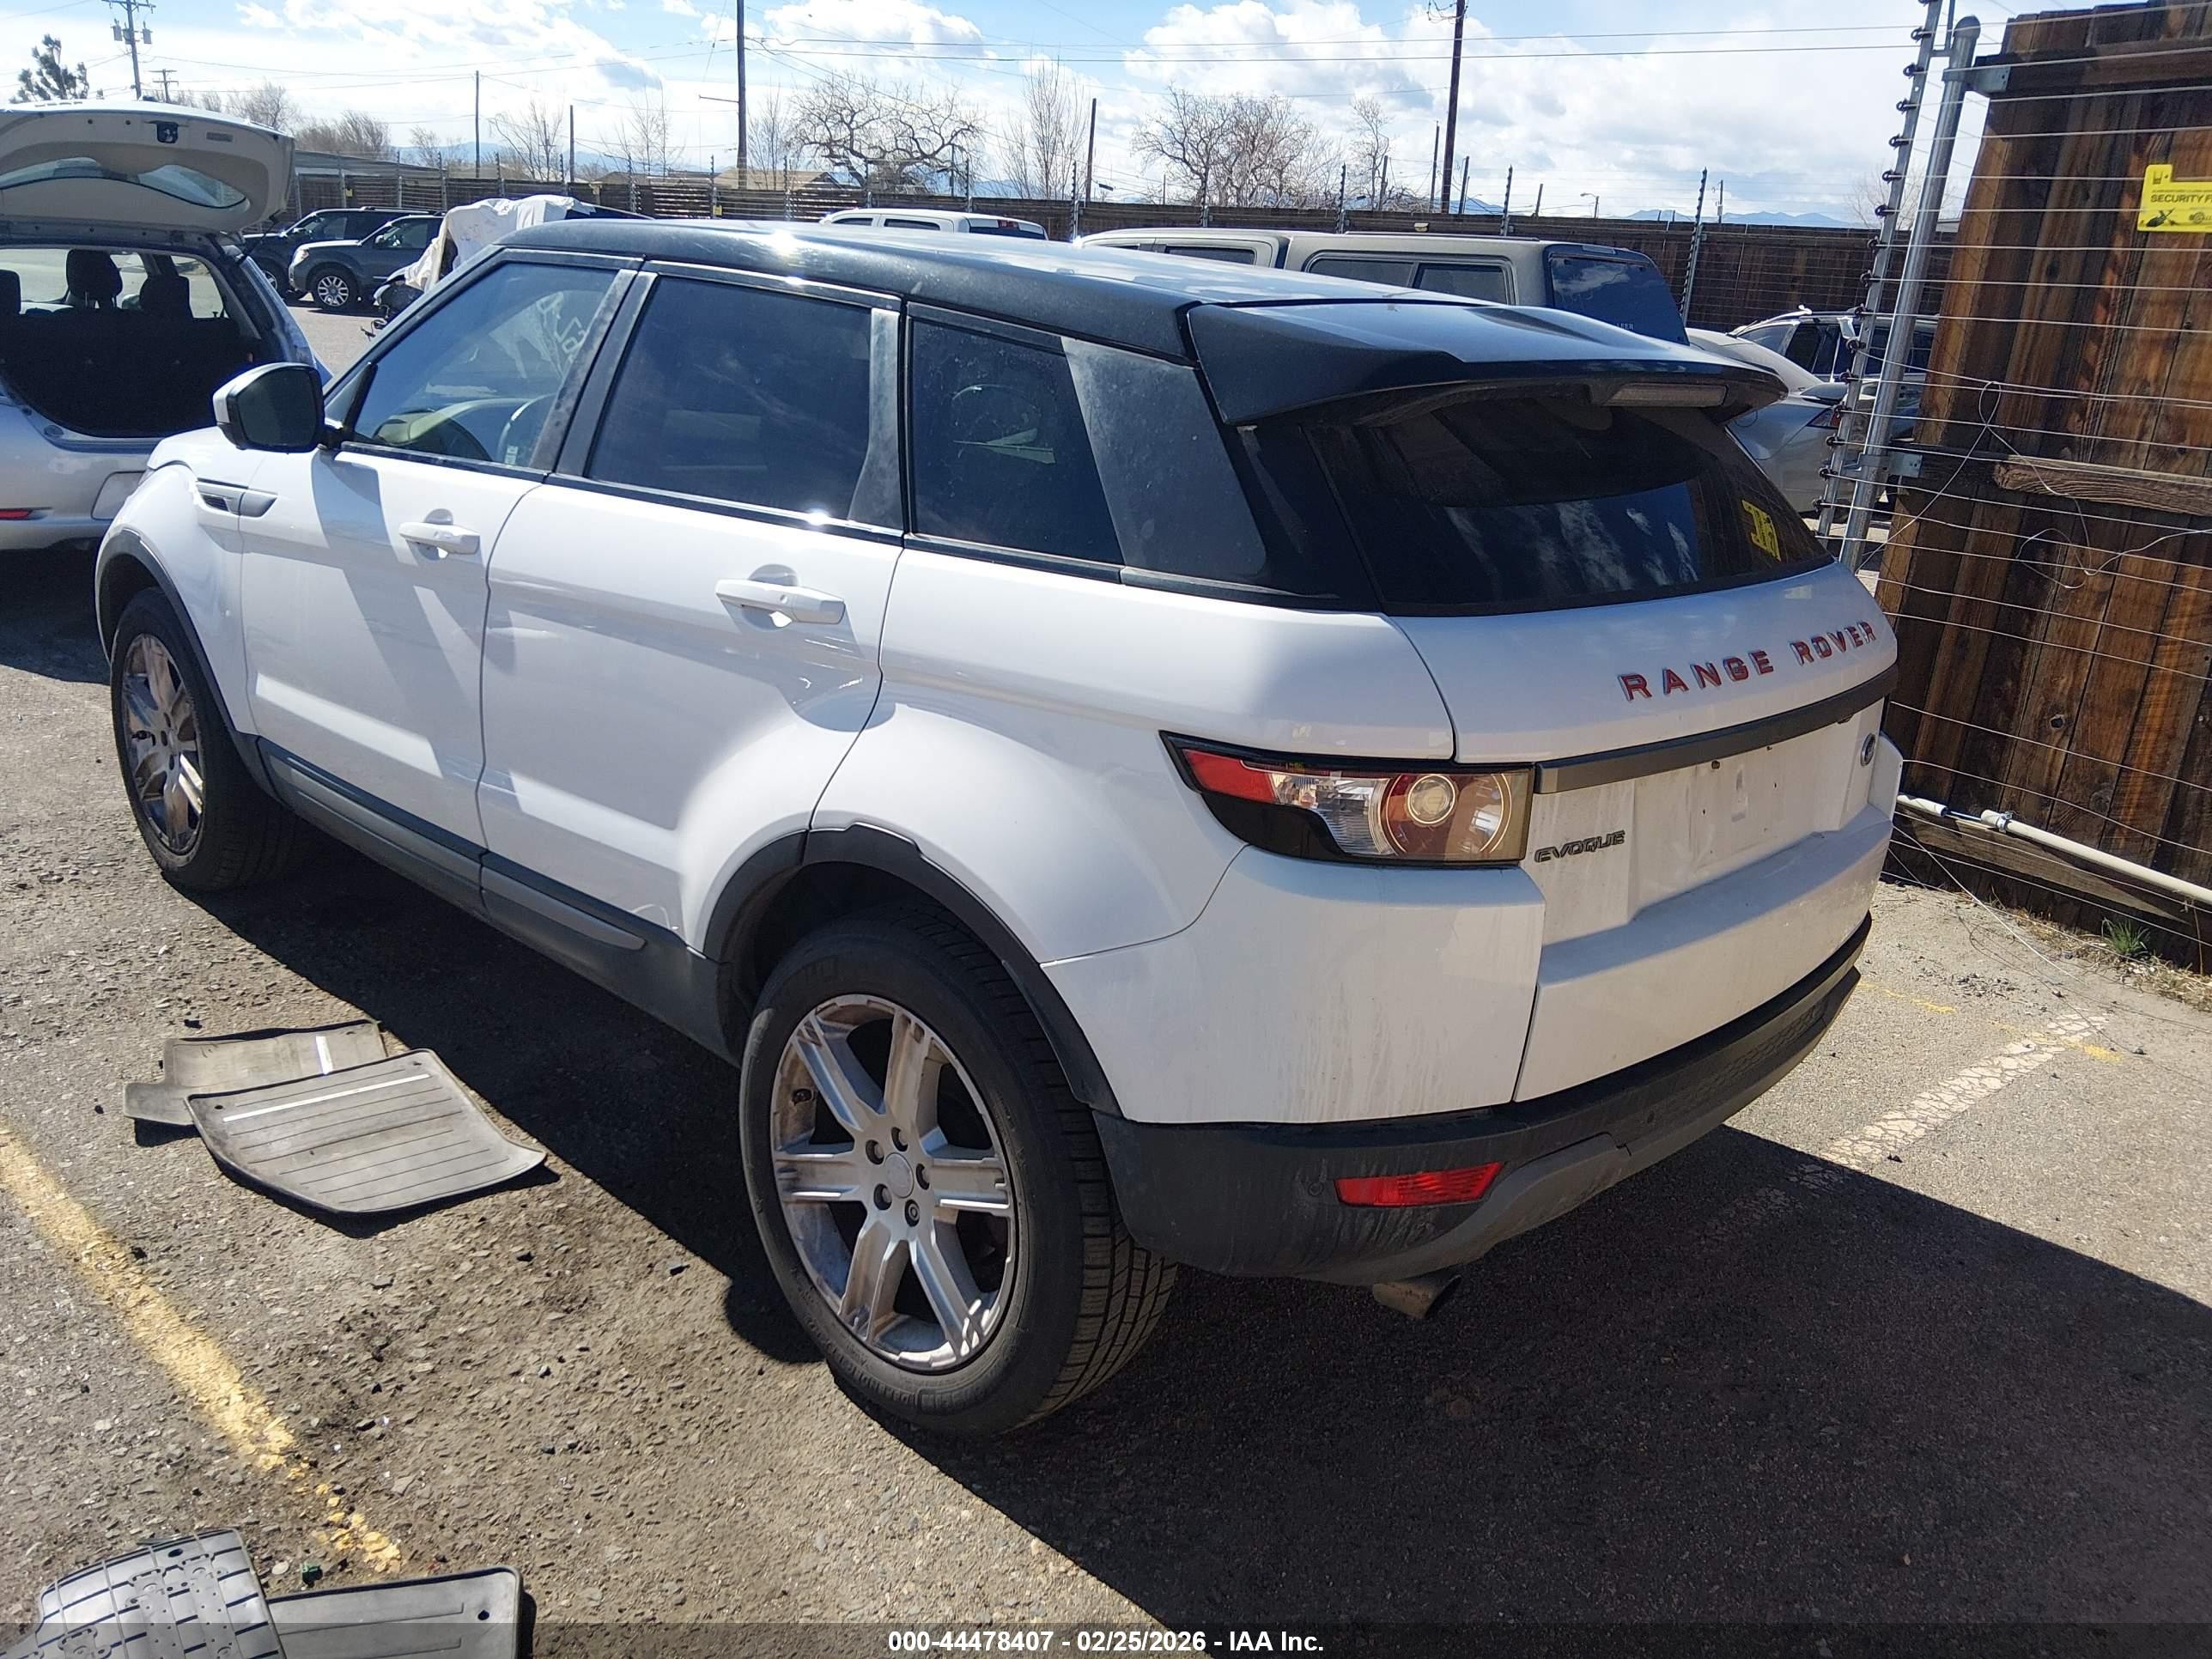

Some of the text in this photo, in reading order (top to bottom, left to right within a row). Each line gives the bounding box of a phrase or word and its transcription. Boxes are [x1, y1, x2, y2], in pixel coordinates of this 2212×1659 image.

[2150, 194, 2203, 203] SECURITY
[1618, 621, 1876, 702] RANGE ROVER
[1534, 830, 1626, 863] EVOQUE
